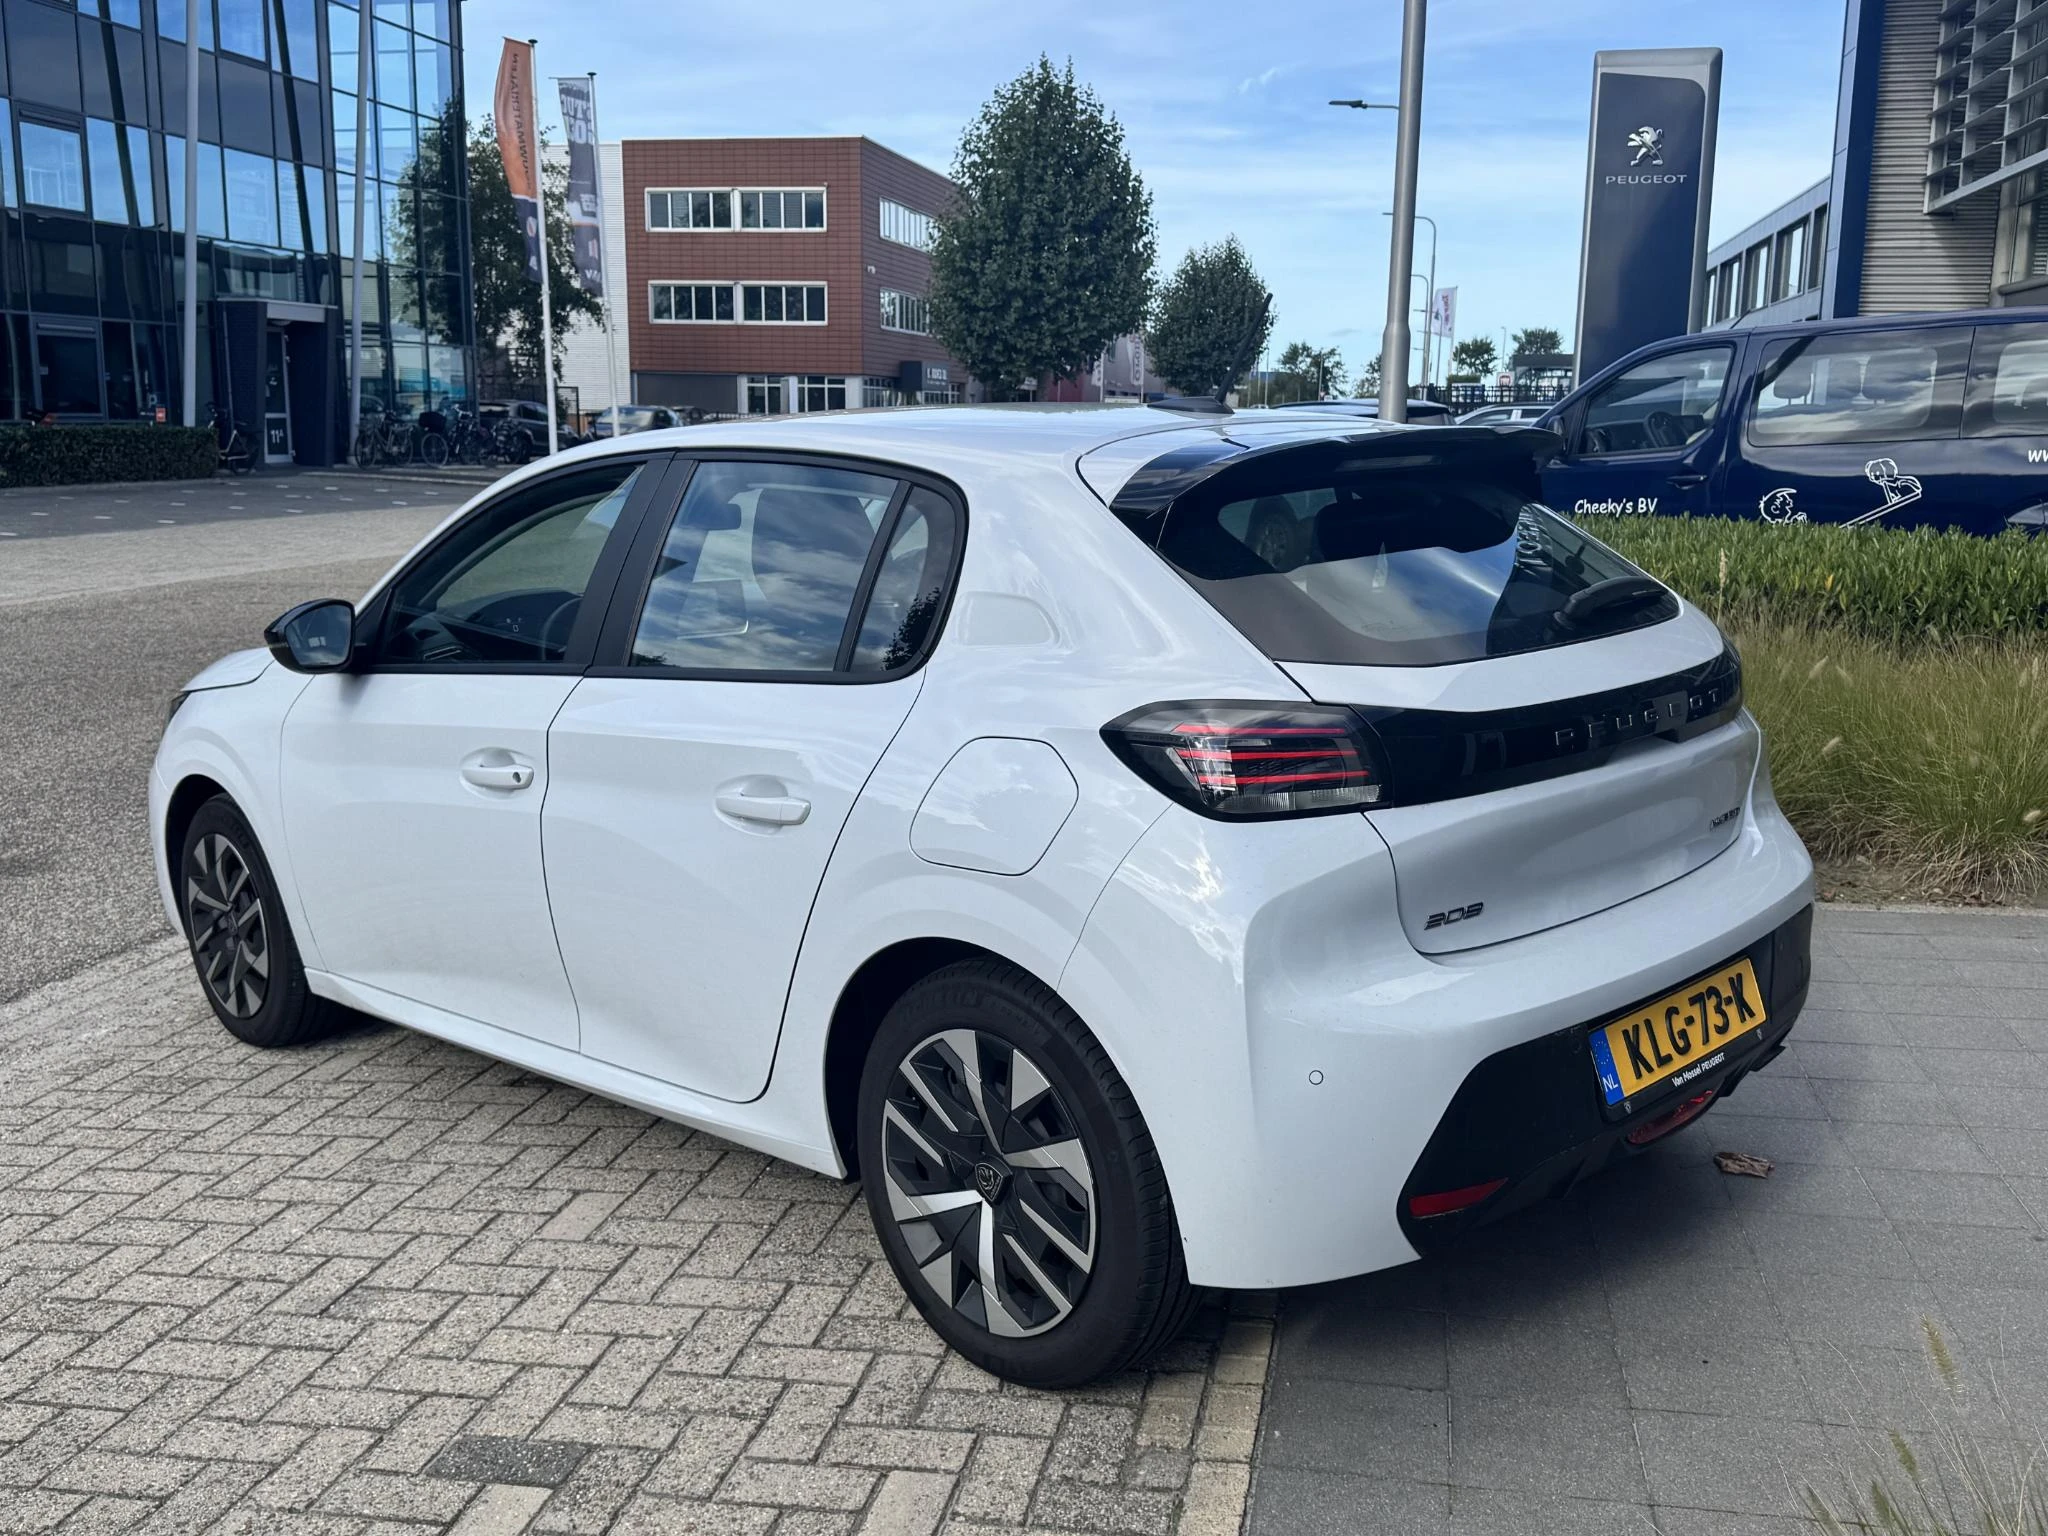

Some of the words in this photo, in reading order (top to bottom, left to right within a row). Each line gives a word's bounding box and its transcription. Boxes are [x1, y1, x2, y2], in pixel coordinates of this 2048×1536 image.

[1605, 174, 1688, 184] PEUGEOT
[1574, 498, 1633, 518] Cheeky's
[1637, 497, 1658, 513] BV
[1555, 688, 1719, 746] PEUGEOT
[1424, 901, 1484, 931] 208
[1621, 972, 1756, 1080] KLG-73-K
[1602, 1074, 1619, 1093] NL
[1671, 1076, 1685, 1087] Van
[1682, 1063, 1702, 1082] Mossel
[1701, 1052, 1725, 1071] PEUGEOT
